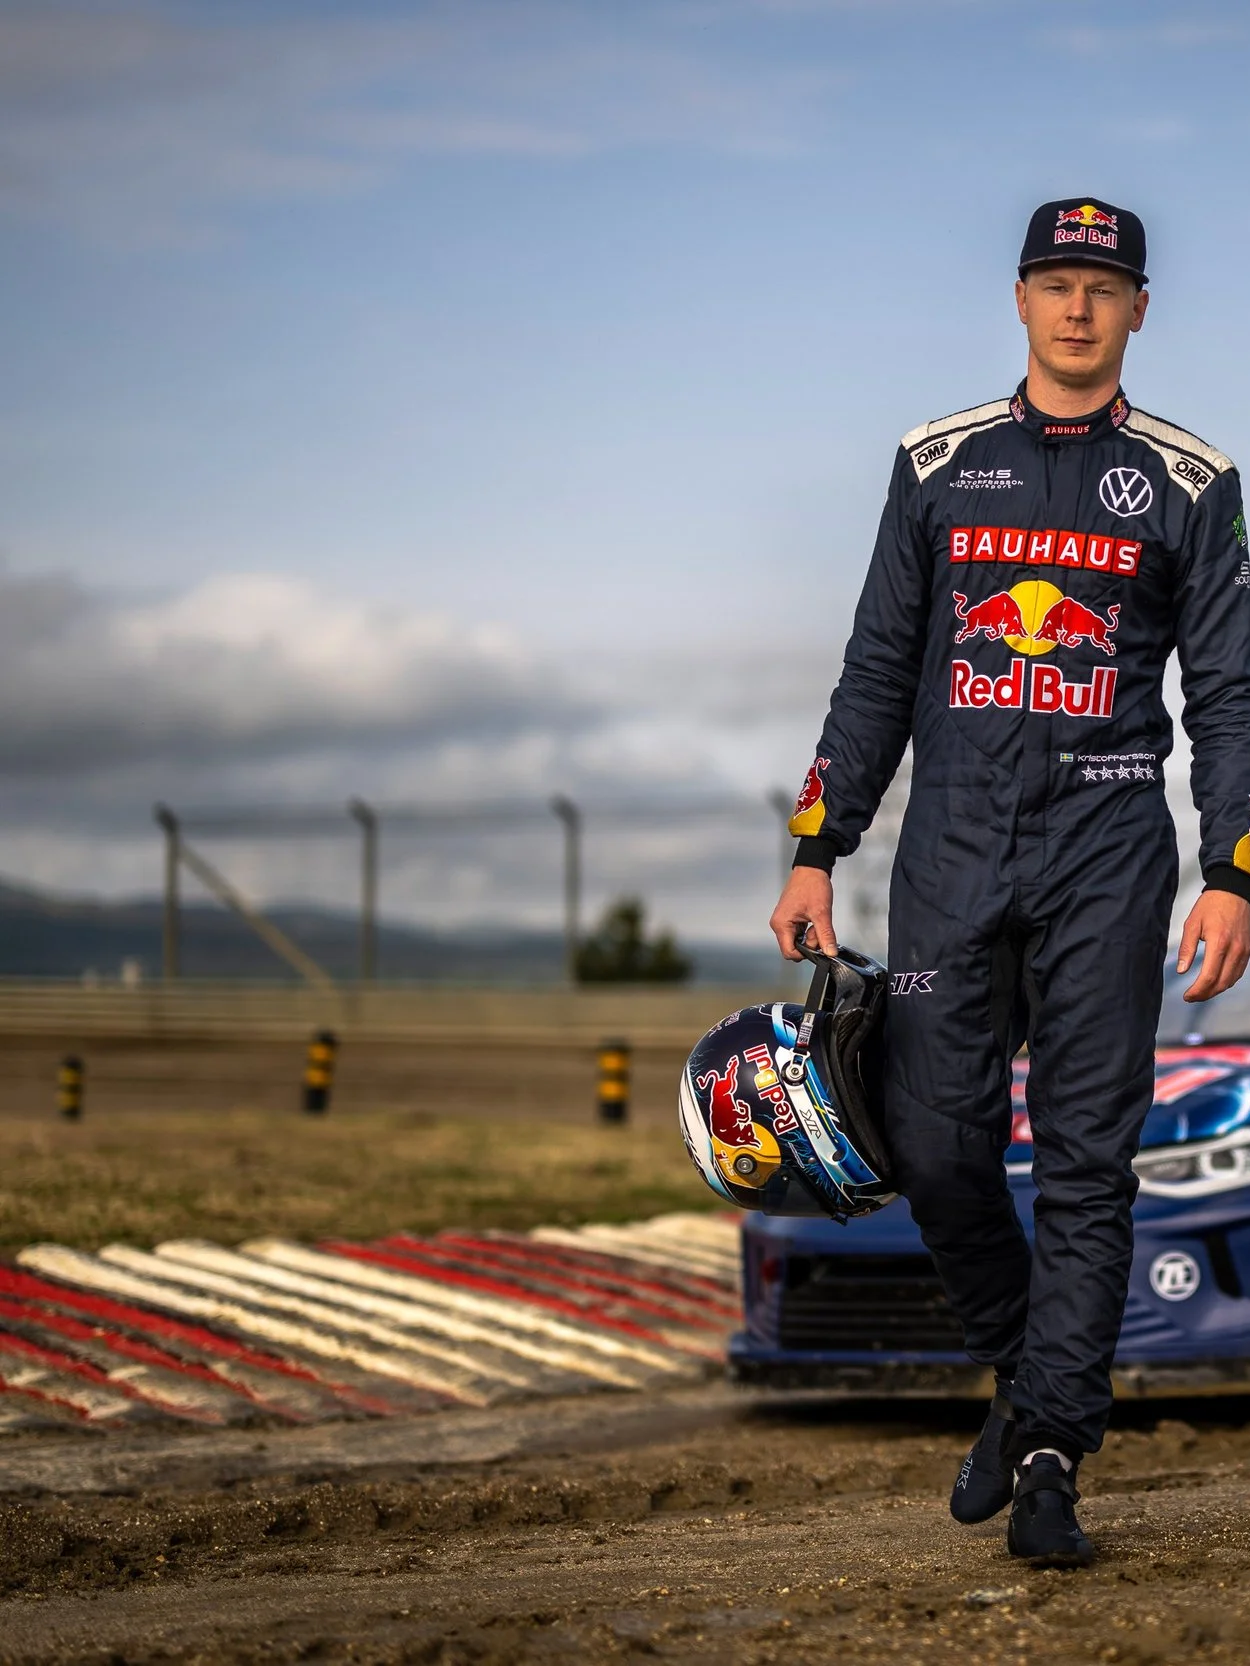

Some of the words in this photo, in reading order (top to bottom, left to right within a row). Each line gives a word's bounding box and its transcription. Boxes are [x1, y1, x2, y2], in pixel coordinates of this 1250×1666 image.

[1054, 226, 1086, 244] Red
[1088, 228, 1117, 249] Bull
[1045, 425, 1090, 434] BAUHAUS
[917, 441, 949, 465] OMP
[960, 469, 1012, 479] KMS
[1175, 460, 1208, 486] OMP
[953, 532, 1140, 571] BAUHAUS
[949, 657, 1026, 708] Red
[1029, 663, 1118, 717] Bull
[743, 1043, 780, 1092] Bull
[758, 1084, 799, 1136] Red
